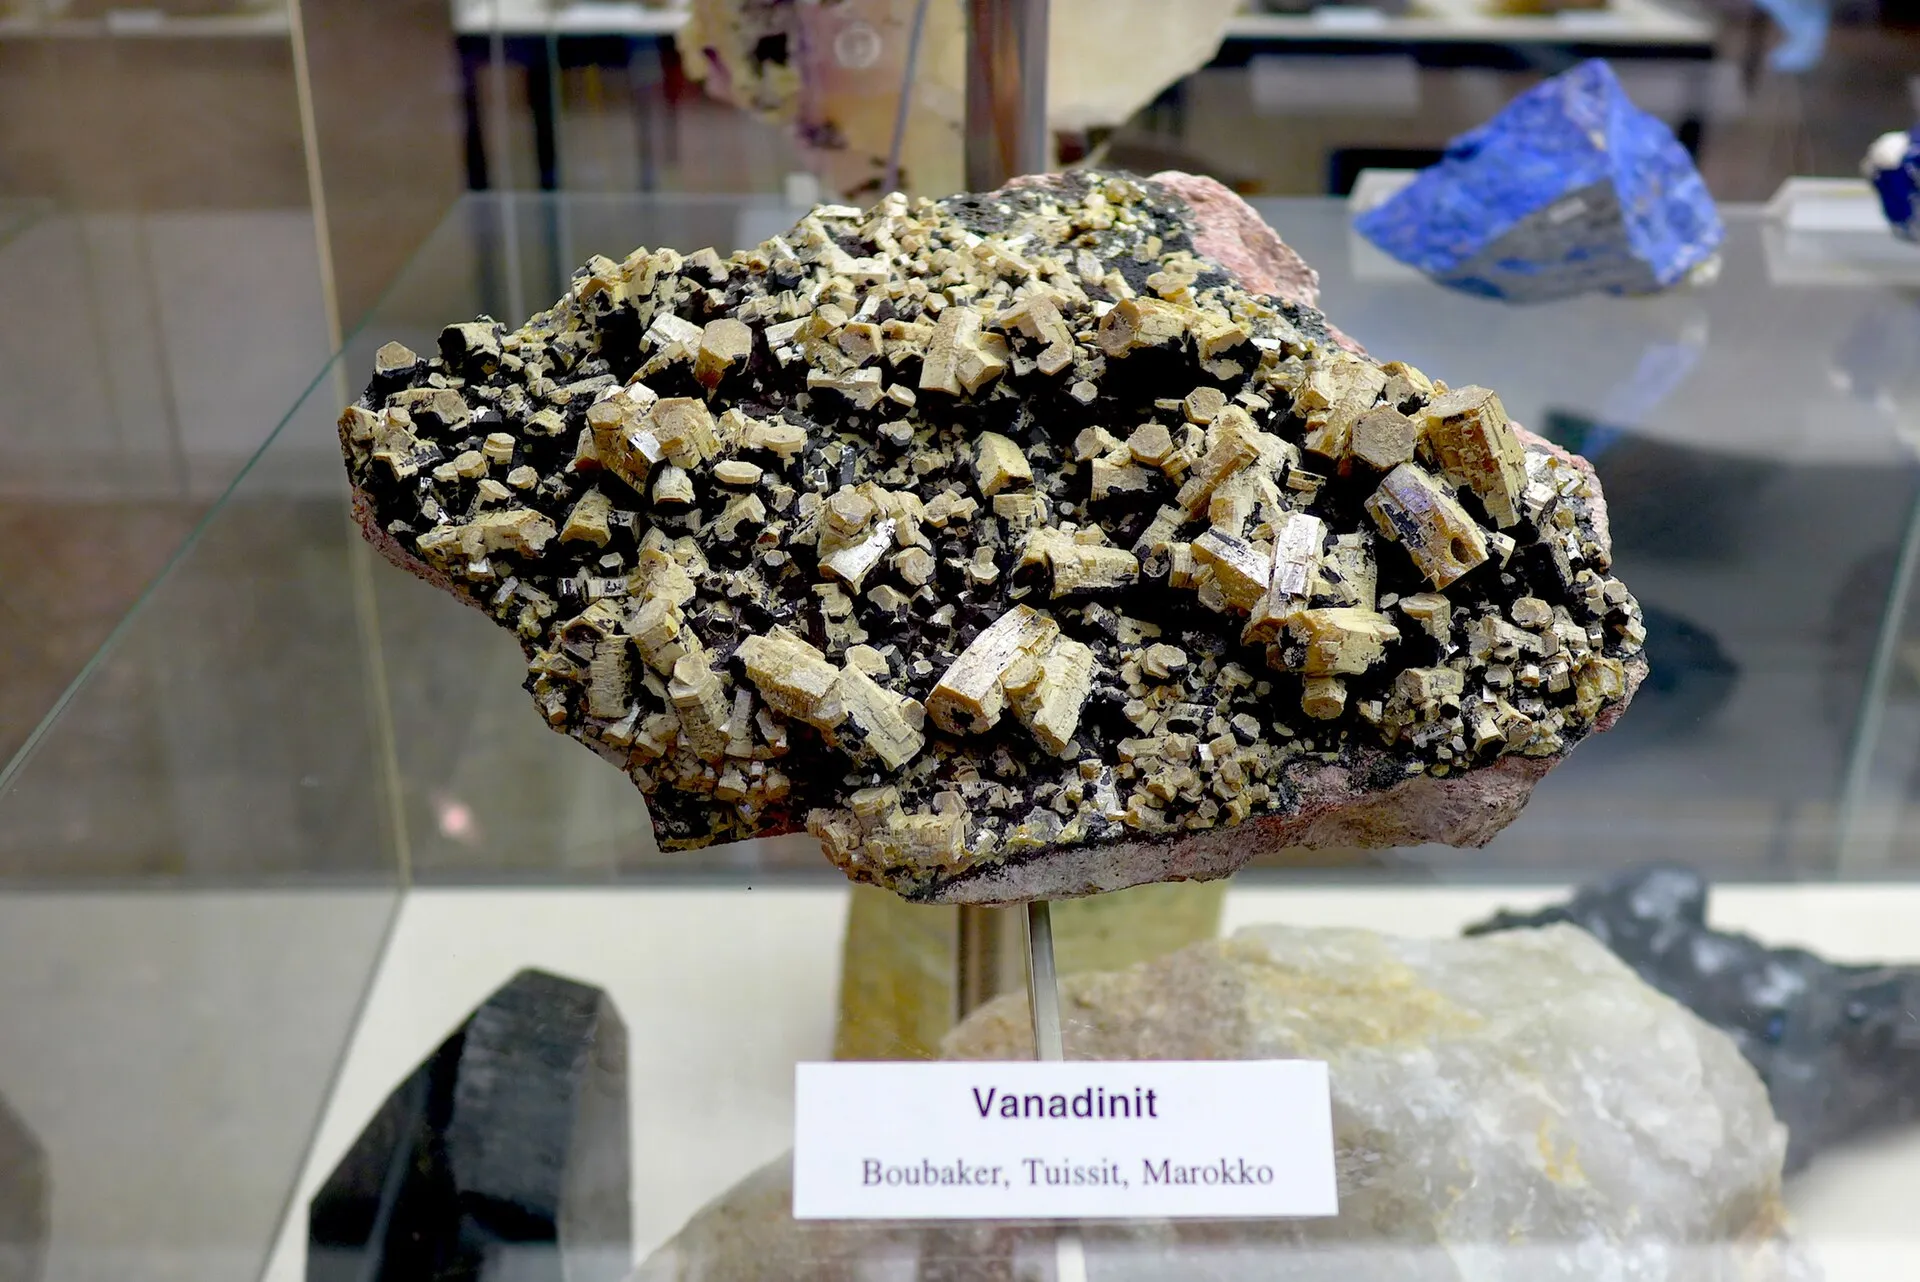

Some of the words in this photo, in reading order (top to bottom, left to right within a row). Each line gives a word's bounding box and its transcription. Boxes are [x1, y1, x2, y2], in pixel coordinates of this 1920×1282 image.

[972, 1086, 1158, 1118] Vanadinit
[862, 1159, 1010, 1187] Boubaker,
[1023, 1159, 1128, 1187] Tuissit,
[1143, 1159, 1275, 1184] Marokko
